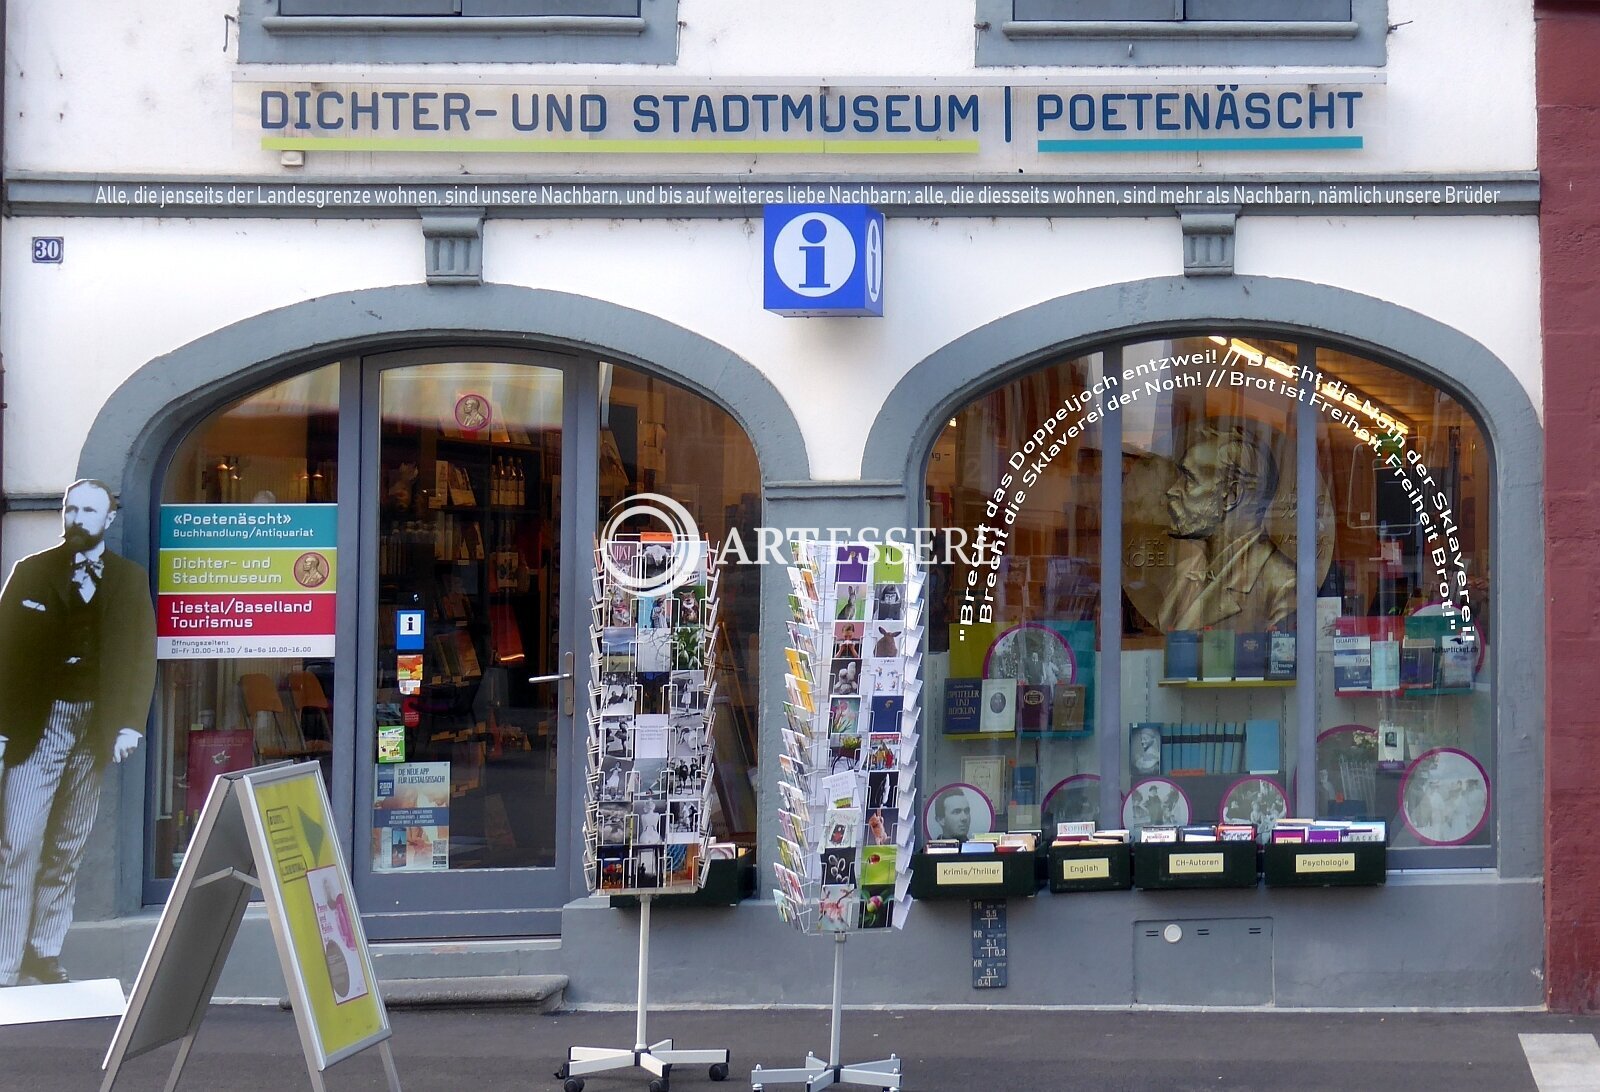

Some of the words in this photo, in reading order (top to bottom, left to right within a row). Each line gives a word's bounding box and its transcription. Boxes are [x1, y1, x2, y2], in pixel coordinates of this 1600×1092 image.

[262, 93, 498, 132] DICHTER-
[513, 96, 607, 133] UND
[634, 95, 979, 133] STADTMUSEUM
[1038, 85, 1364, 131] POETENÄSCHT
[96, 186, 129, 205] Alle,
[135, 186, 157, 204] die
[161, 186, 223, 208] jenseits
[228, 186, 254, 204] der
[258, 186, 370, 208] Landesgrenze
[375, 186, 441, 205] wohnen,
[446, 186, 477, 204] sind
[482, 190, 536, 204] unsere
[542, 186, 622, 205] Nachbarn,
[627, 186, 654, 204] und
[660, 186, 682, 204] bis
[686, 186, 710, 204] auf
[715, 186, 783, 204] weiteres
[788, 186, 825, 204] liebe
[830, 186, 910, 205] Nachbarn;
[915, 186, 946, 205] alle,
[952, 186, 974, 204] die
[979, 186, 1049, 204] diesseits
[1053, 186, 1119, 205] wohnen,
[1124, 186, 1155, 204] sind
[1161, 186, 1202, 204] mehr
[1207, 186, 1229, 204] als
[1235, 186, 1314, 205] Nachbarn,
[1320, 186, 1381, 204] nämlich
[1386, 190, 1440, 204] unsere
[1446, 186, 1500, 204] Brüder
[35, 240, 59, 258] 30
[979, 529, 1009, 624] Brecht
[1004, 490, 1026, 524] die
[1022, 403, 1105, 488] Sklaverei
[1107, 388, 1140, 411] der
[1145, 371, 1201, 396] Noth!
[1230, 371, 1276, 392] Brot
[1280, 380, 1306, 402] ist
[1385, 453, 1438, 543] Freiheit
[986, 473, 1013, 518] das
[1008, 375, 1118, 470] Doppeljoch
[1122, 349, 1217, 380] entzwei!
[1406, 449, 1436, 487] der
[1432, 491, 1475, 641] Sklaverei!
[173, 512, 292, 525] «Poetenäscht»
[173, 528, 314, 539] Buchhandlung/Antiquariat
[172, 557, 237, 569] Dichter-
[242, 557, 271, 569] und
[172, 572, 282, 584] Stadtmuseum
[171, 598, 312, 614] Liestal/Baselland
[171, 615, 253, 628] Tourismus
[1070, 864, 1098, 874] English
[1175, 858, 1220, 867] CH-Autoren
[1302, 858, 1349, 868] Psychologie
[943, 866, 1000, 876] Krimis/Thriller
